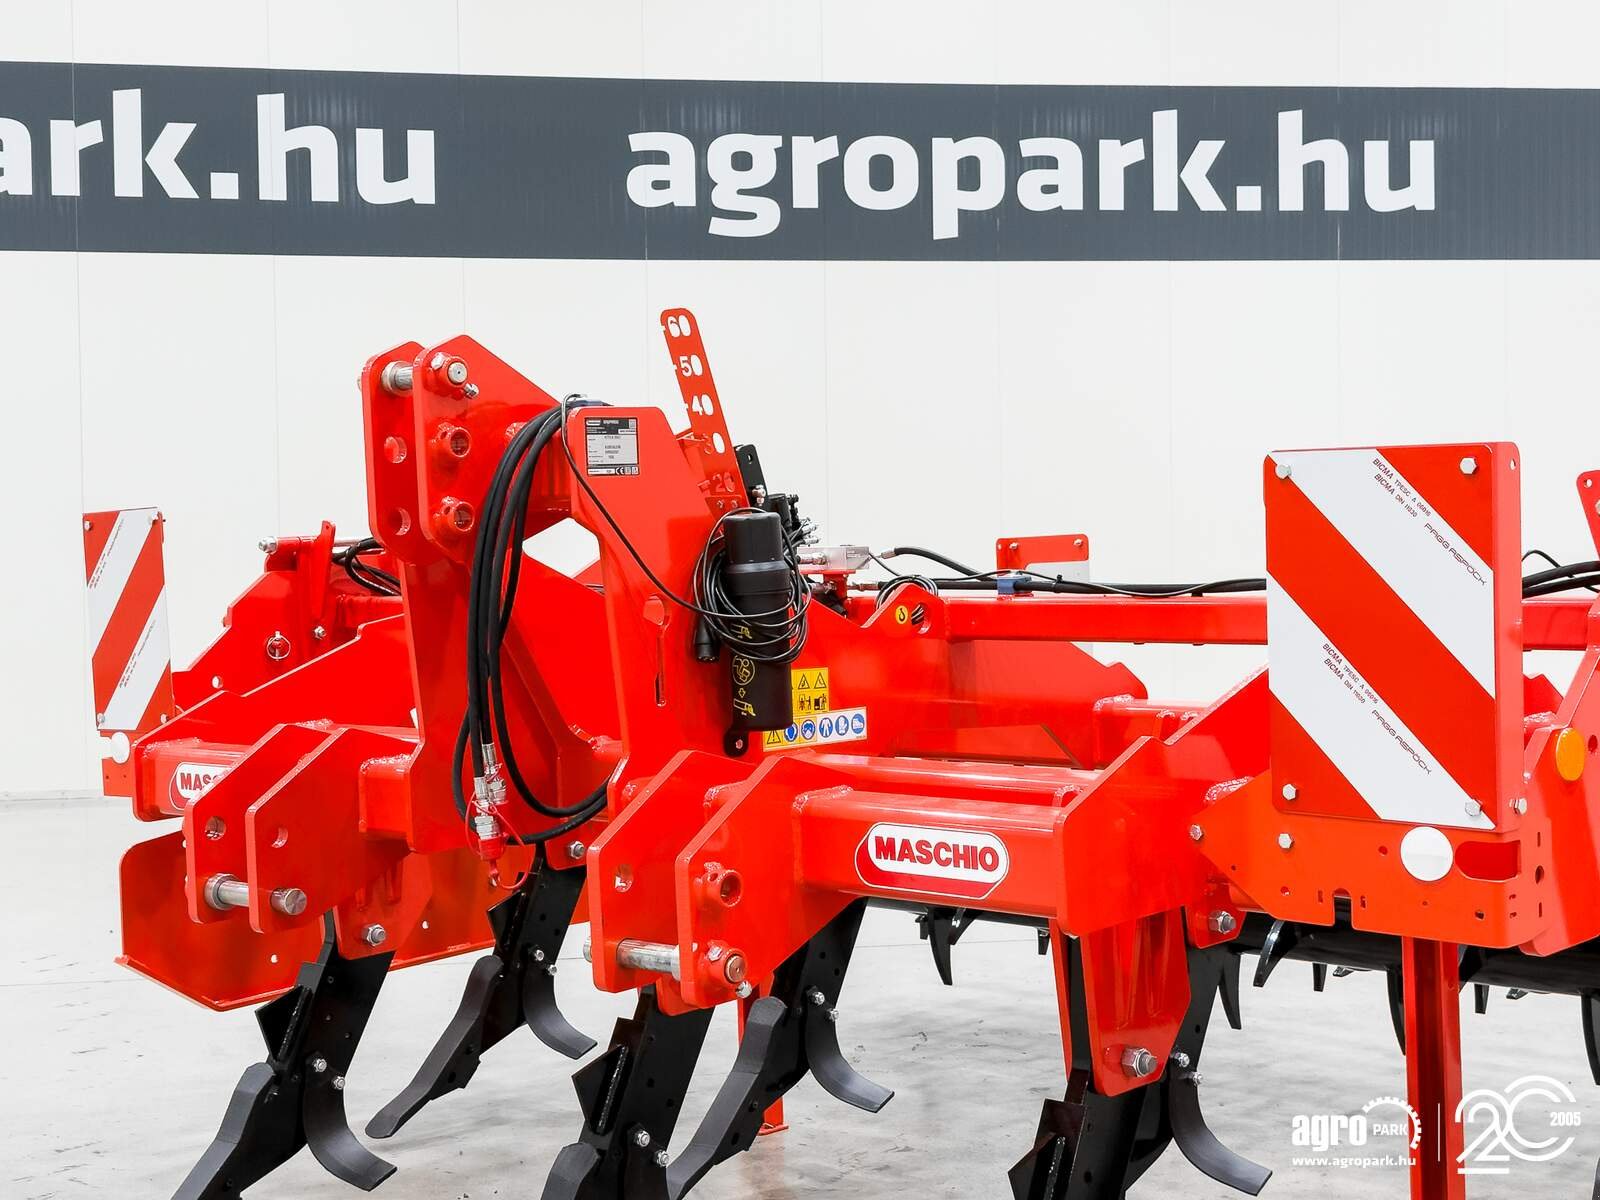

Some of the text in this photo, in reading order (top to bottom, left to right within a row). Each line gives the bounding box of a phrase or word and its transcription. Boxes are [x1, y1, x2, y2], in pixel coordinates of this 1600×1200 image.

[626, 109, 1436, 240] agropark.hu
[667, 314, 691, 337] 60
[679, 354, 703, 377] 50
[691, 394, 714, 416] 40
[1372, 458, 1394, 479] BICMA
[1374, 473, 1395, 495] BICMA
[1322, 643, 1343, 665] BICMA
[1324, 658, 1345, 680] BICMA
[875, 835, 1000, 872] MASCHIO
